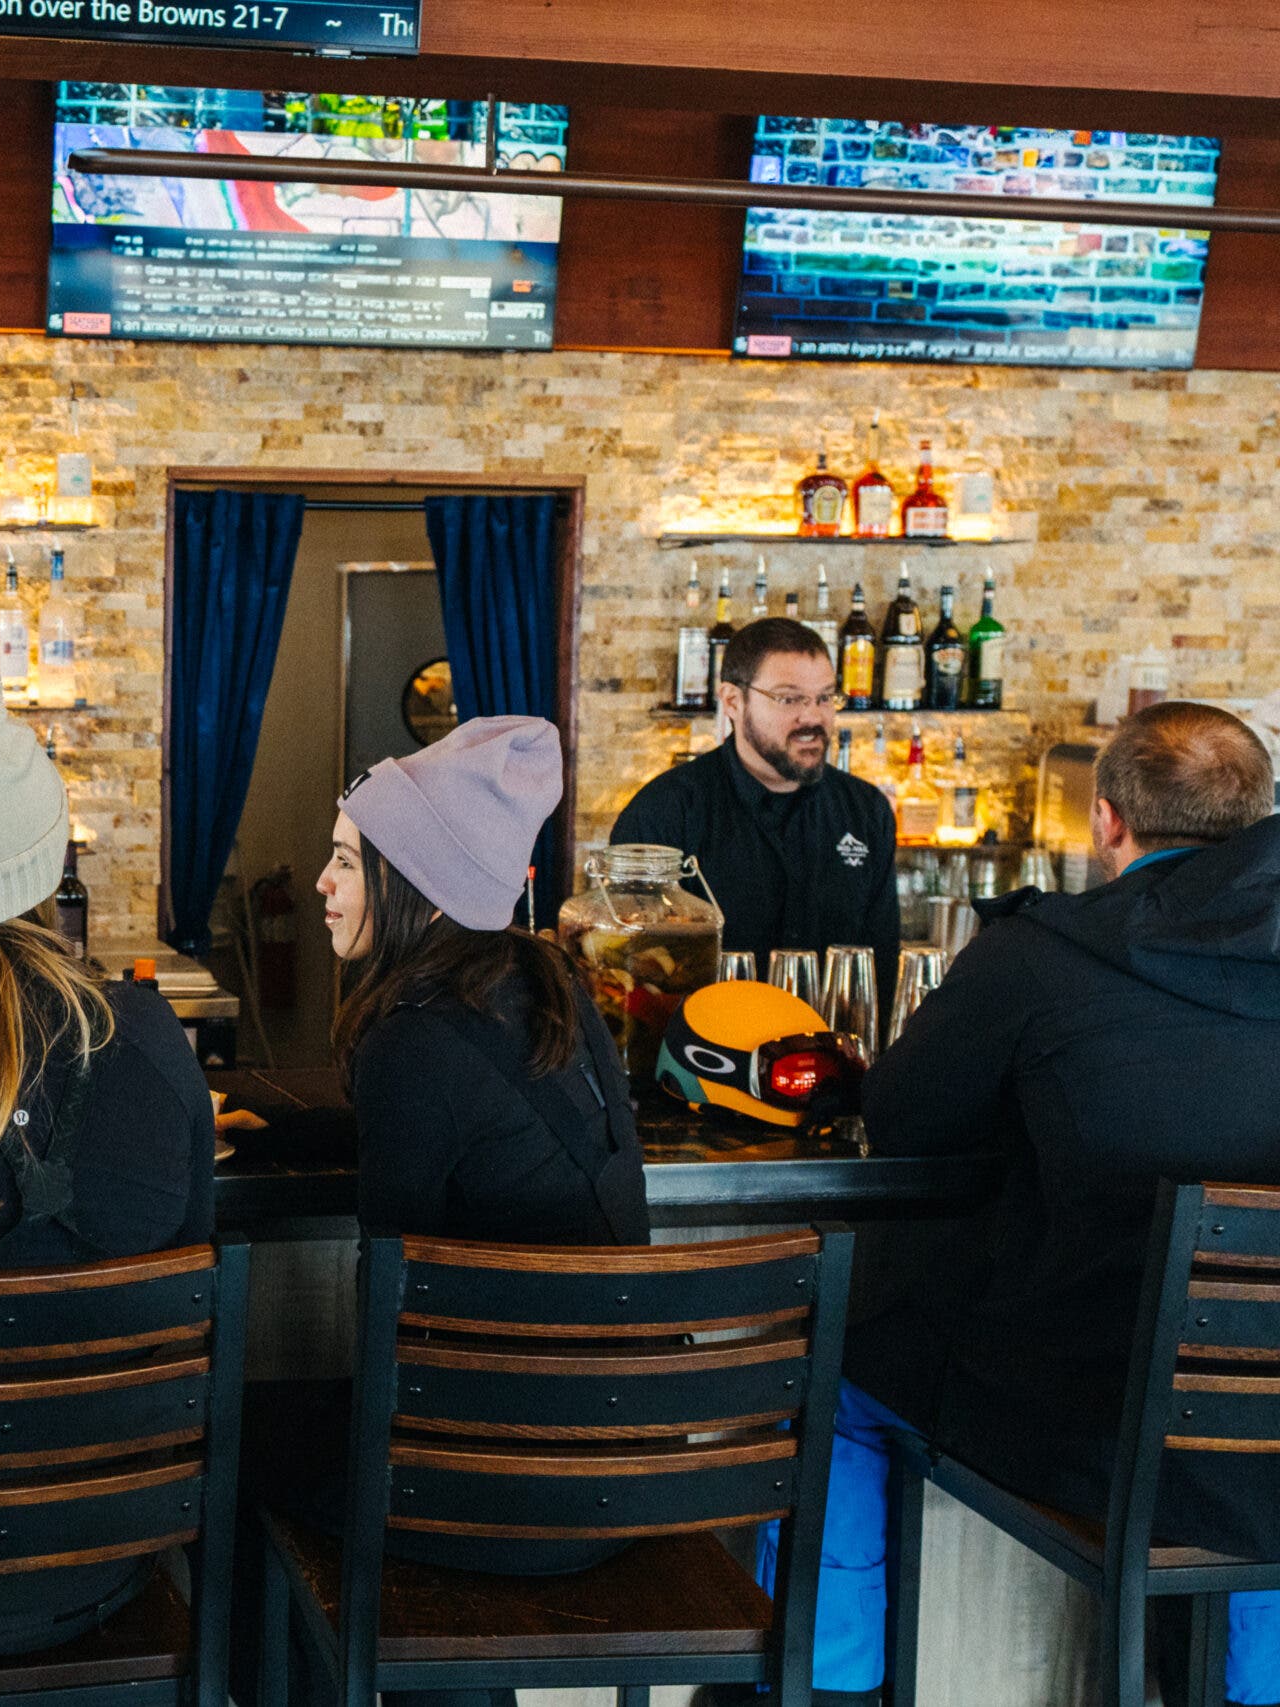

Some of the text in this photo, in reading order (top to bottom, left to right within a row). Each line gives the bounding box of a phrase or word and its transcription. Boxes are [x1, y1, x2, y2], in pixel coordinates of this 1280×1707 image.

[29, 0, 85, 19] over
[90, 0, 131, 22] the
[138, 0, 226, 27] Browns
[232, 4, 288, 30] 21-7
